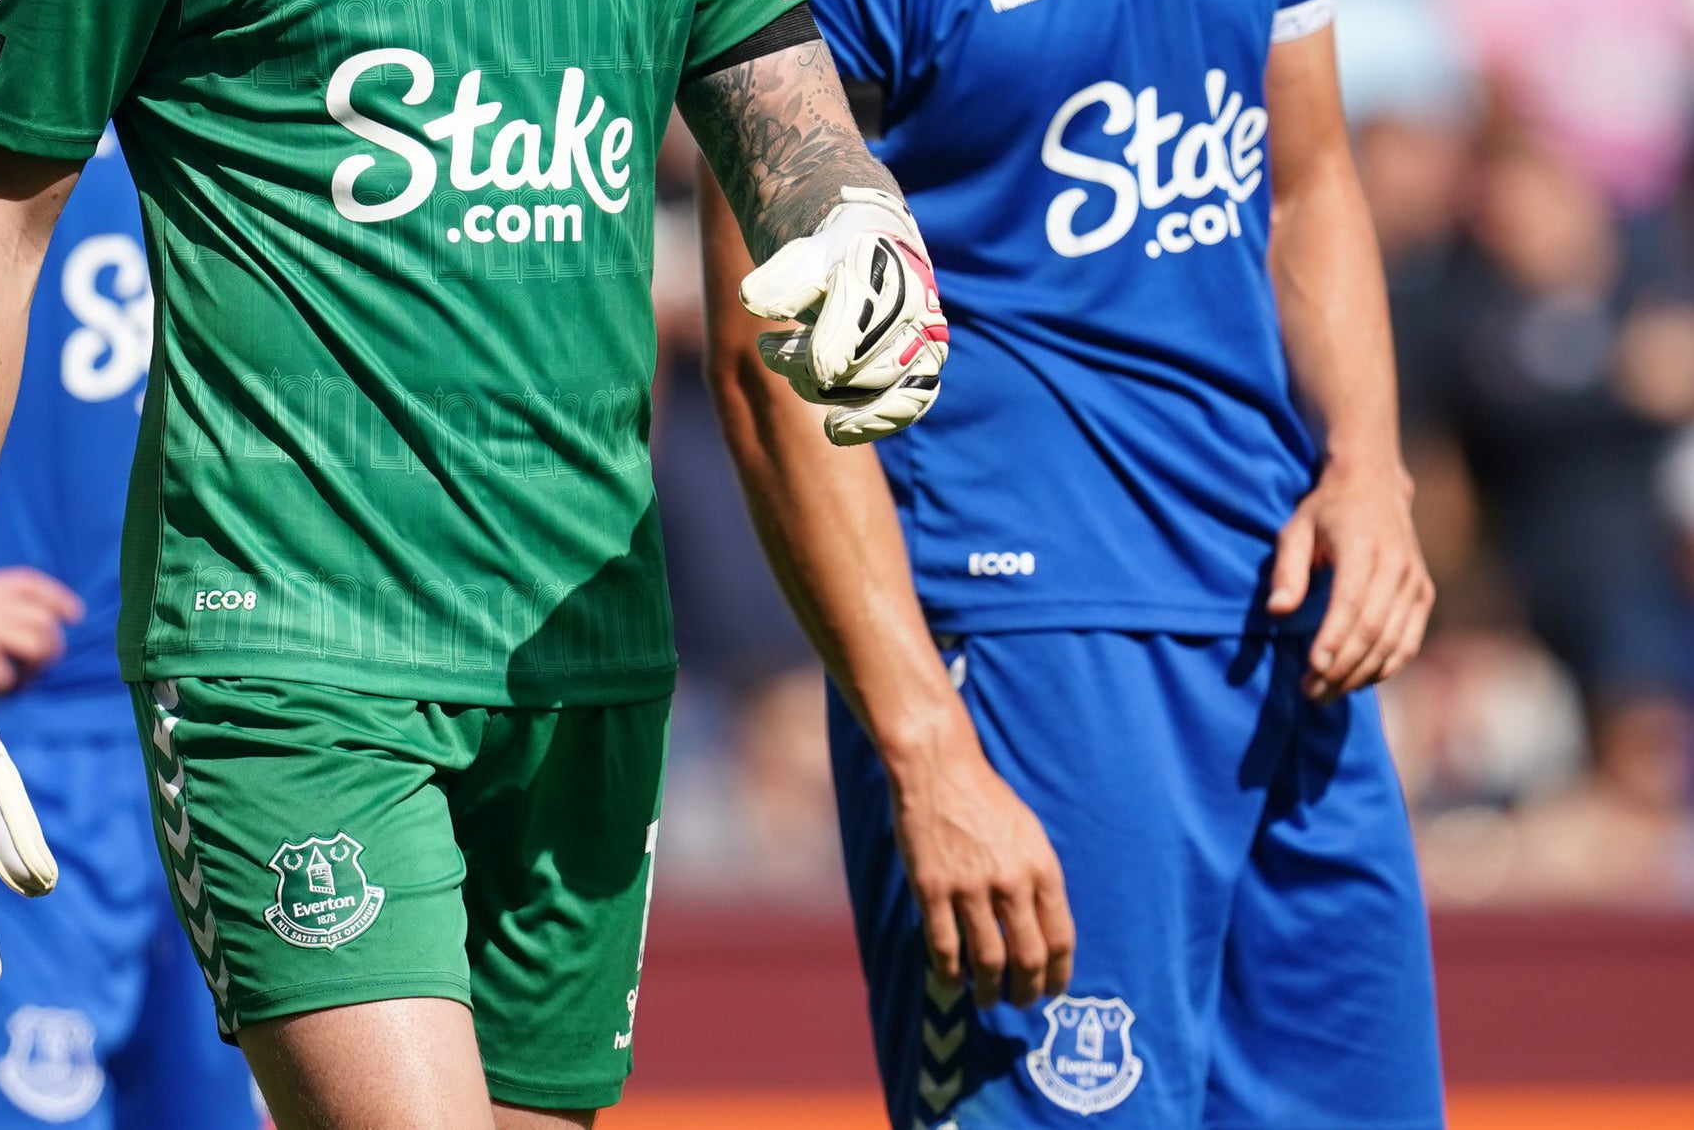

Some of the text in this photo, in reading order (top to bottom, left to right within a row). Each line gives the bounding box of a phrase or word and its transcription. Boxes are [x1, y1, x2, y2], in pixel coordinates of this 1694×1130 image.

[326, 48, 634, 223] Stake
[446, 204, 583, 244] .com
[195, 590, 257, 611] ECO8
[276, 901, 377, 943] NIL SATIS NISI OPTIMUM
[292, 895, 356, 918] Everton
[316, 913, 337, 926] 1878
